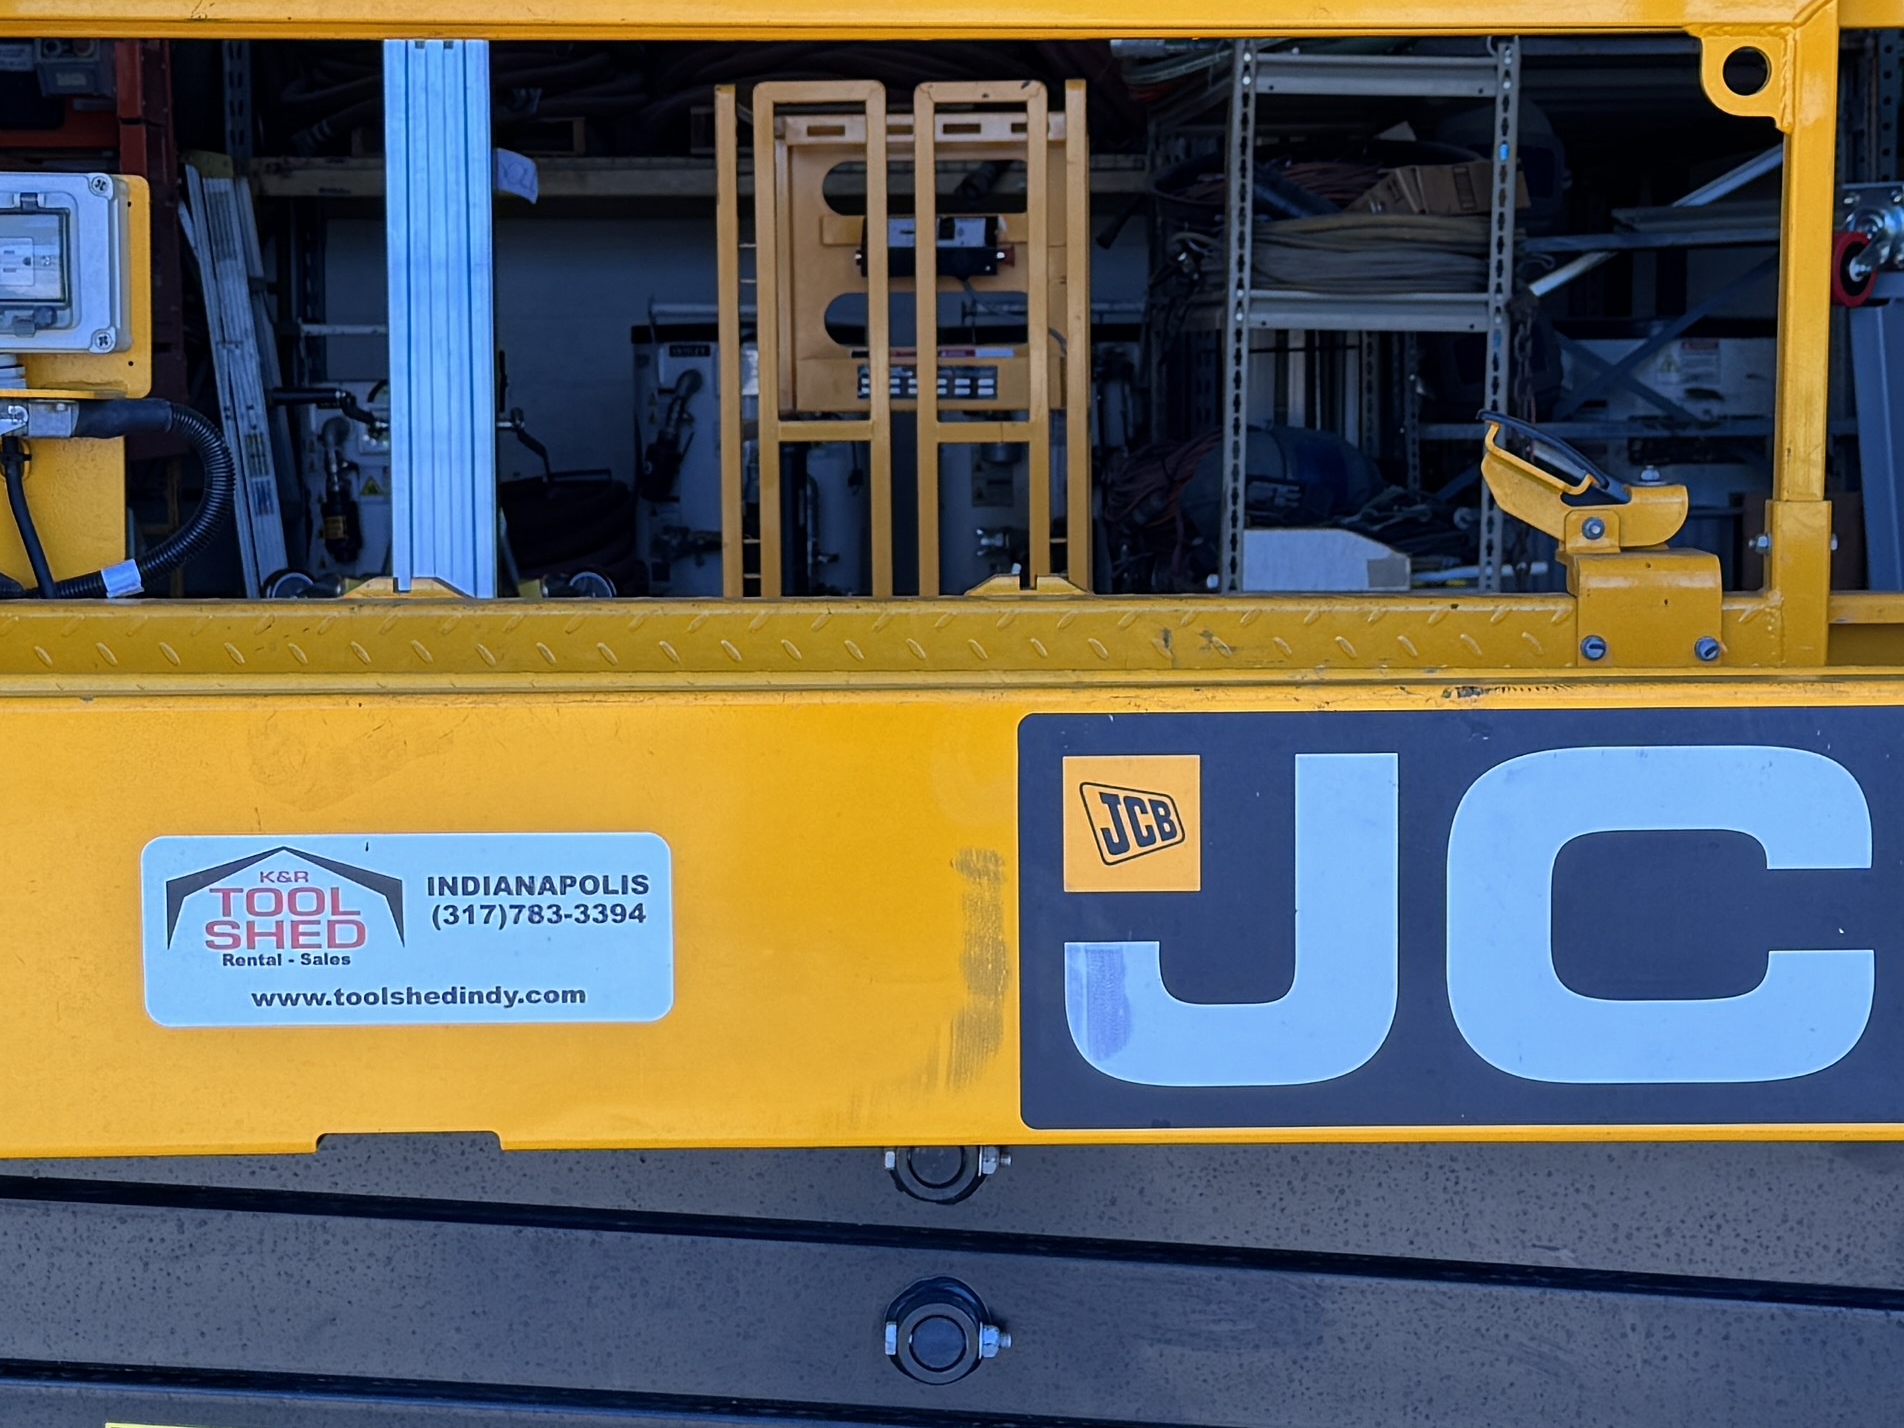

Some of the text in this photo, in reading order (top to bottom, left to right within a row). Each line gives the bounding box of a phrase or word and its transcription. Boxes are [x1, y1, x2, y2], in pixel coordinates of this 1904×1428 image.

[1099, 787, 1181, 855] JCB
[259, 869, 310, 884] K&R
[426, 874, 650, 897] INDIANAPOLIS
[209, 886, 362, 918] TOOL
[431, 902, 647, 931] (317)783-3394
[204, 919, 366, 950] SHED
[222, 952, 283, 968] Rental
[300, 952, 351, 968] Sales
[251, 983, 587, 1012] www.toolshedindy.com
